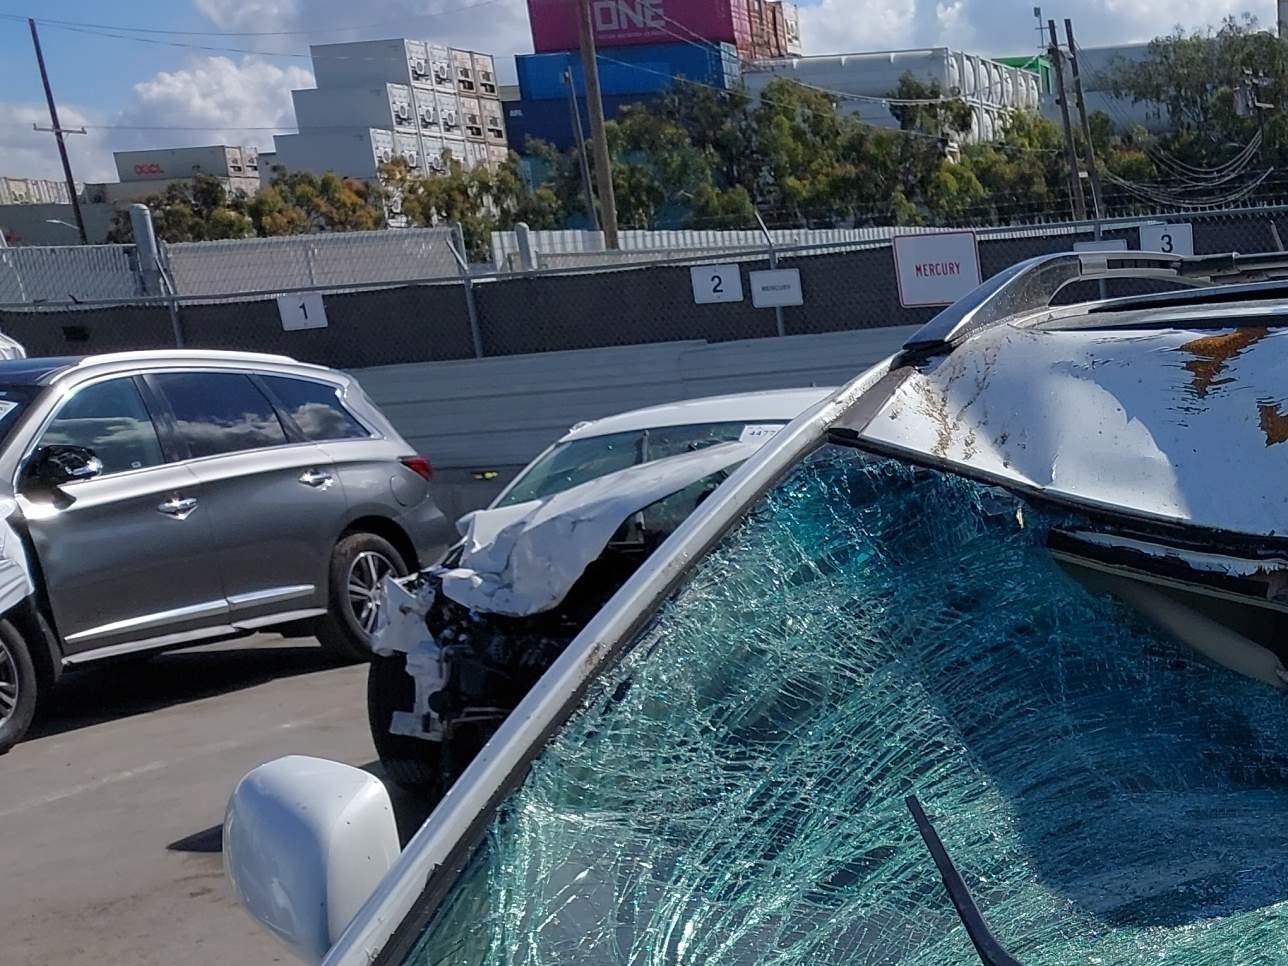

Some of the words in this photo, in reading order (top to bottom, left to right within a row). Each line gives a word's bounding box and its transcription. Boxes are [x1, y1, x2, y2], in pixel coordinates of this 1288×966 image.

[594, 0, 667, 32] ONE
[1161, 234, 1173, 253] 3
[915, 261, 962, 278] MERCURY
[711, 275, 724, 294] 2
[298, 303, 309, 321] 1
